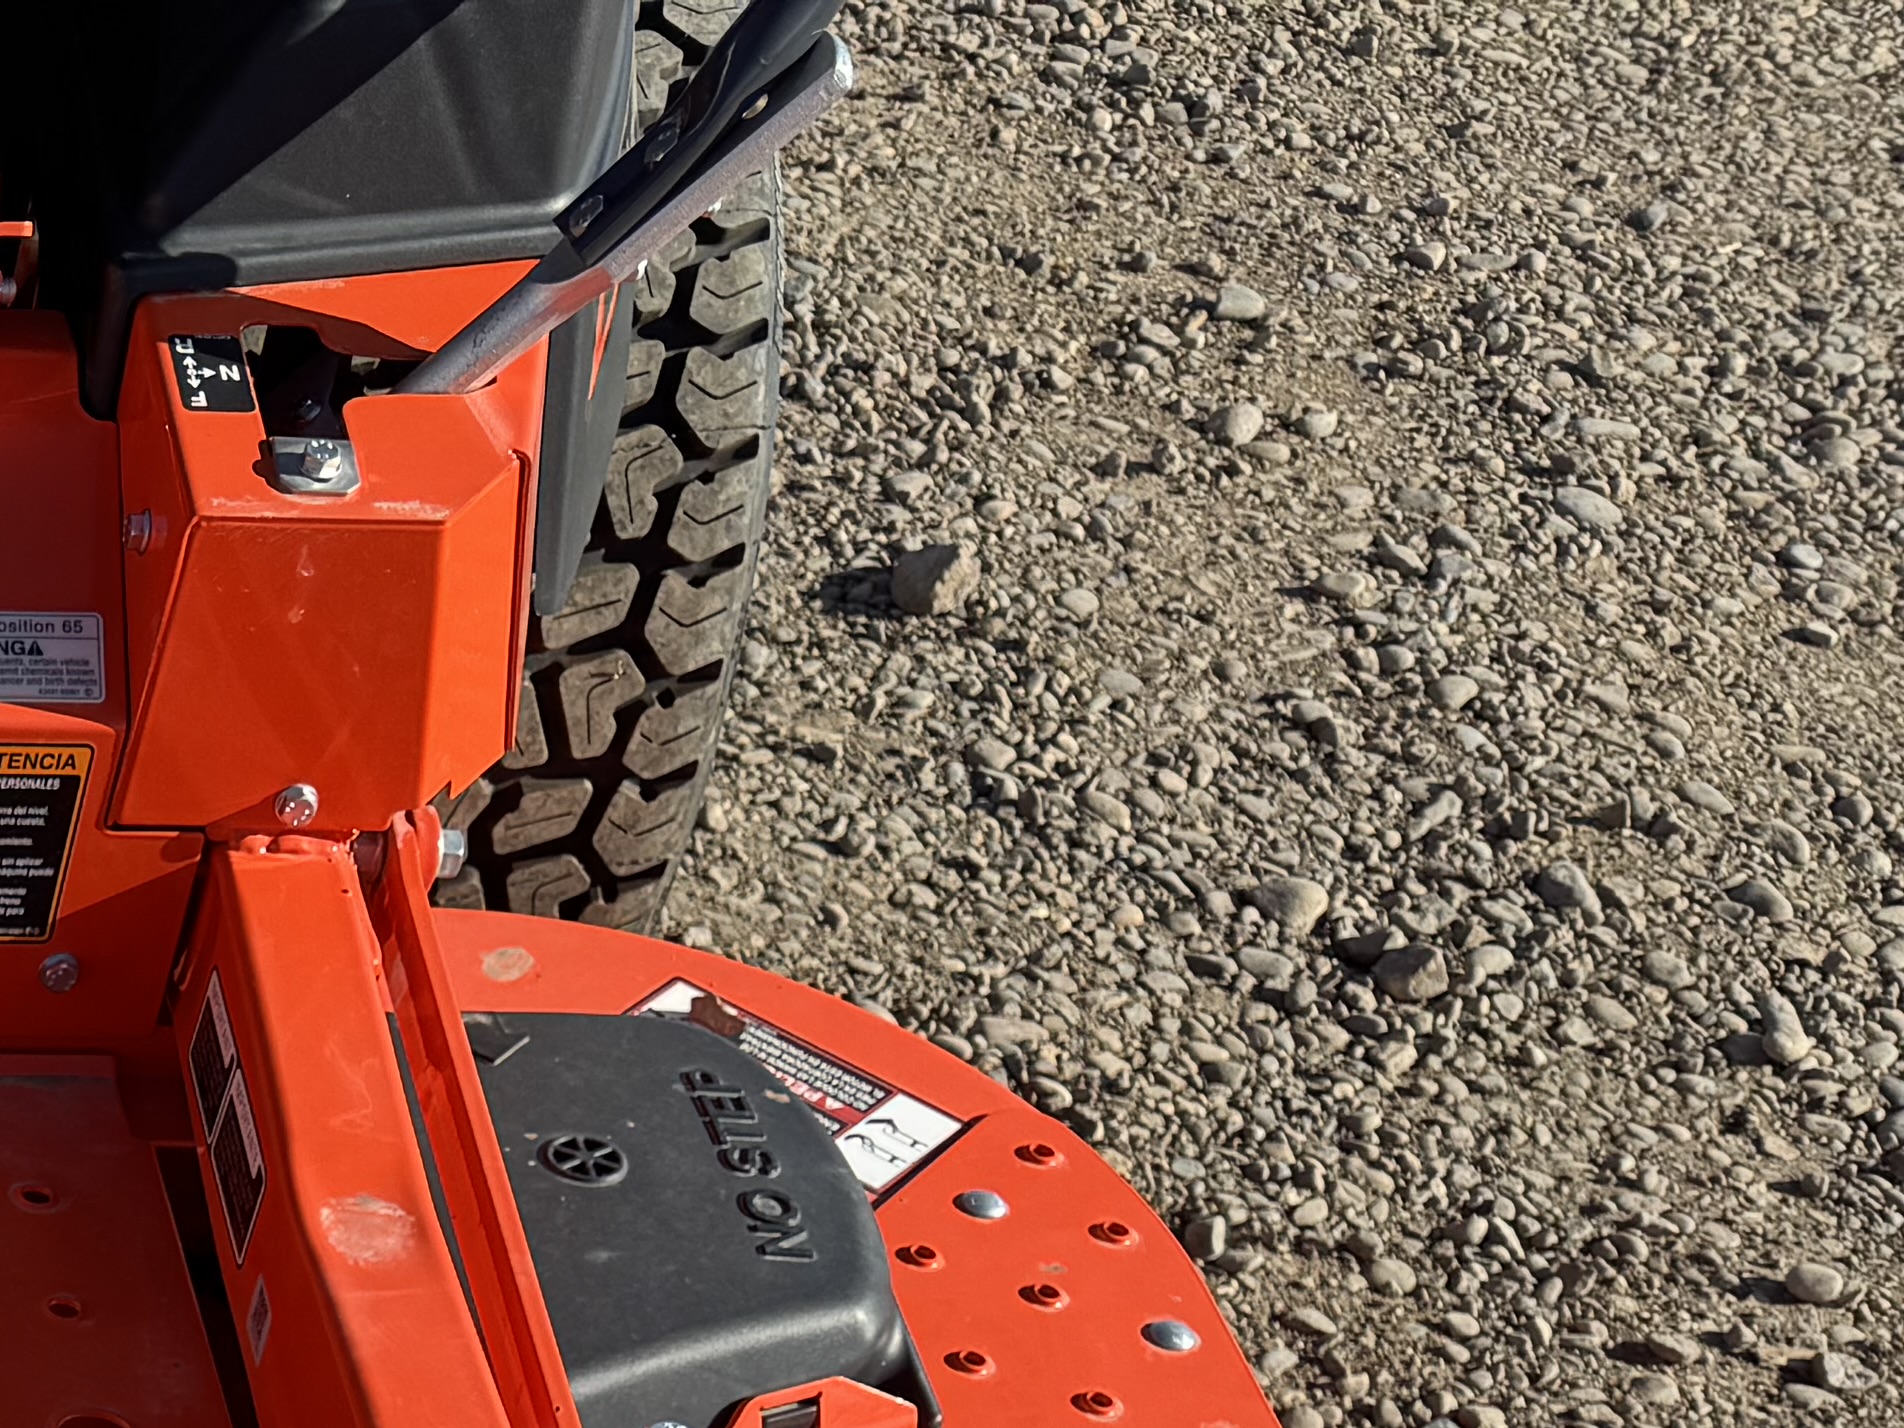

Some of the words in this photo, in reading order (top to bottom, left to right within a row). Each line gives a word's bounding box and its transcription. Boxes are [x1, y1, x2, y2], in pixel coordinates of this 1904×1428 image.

[219, 364, 240, 381] N
[191, 391, 208, 406] F
[62, 620, 83, 634] 65
[678, 1068, 782, 1179] STEP
[736, 1188, 819, 1263] NO
